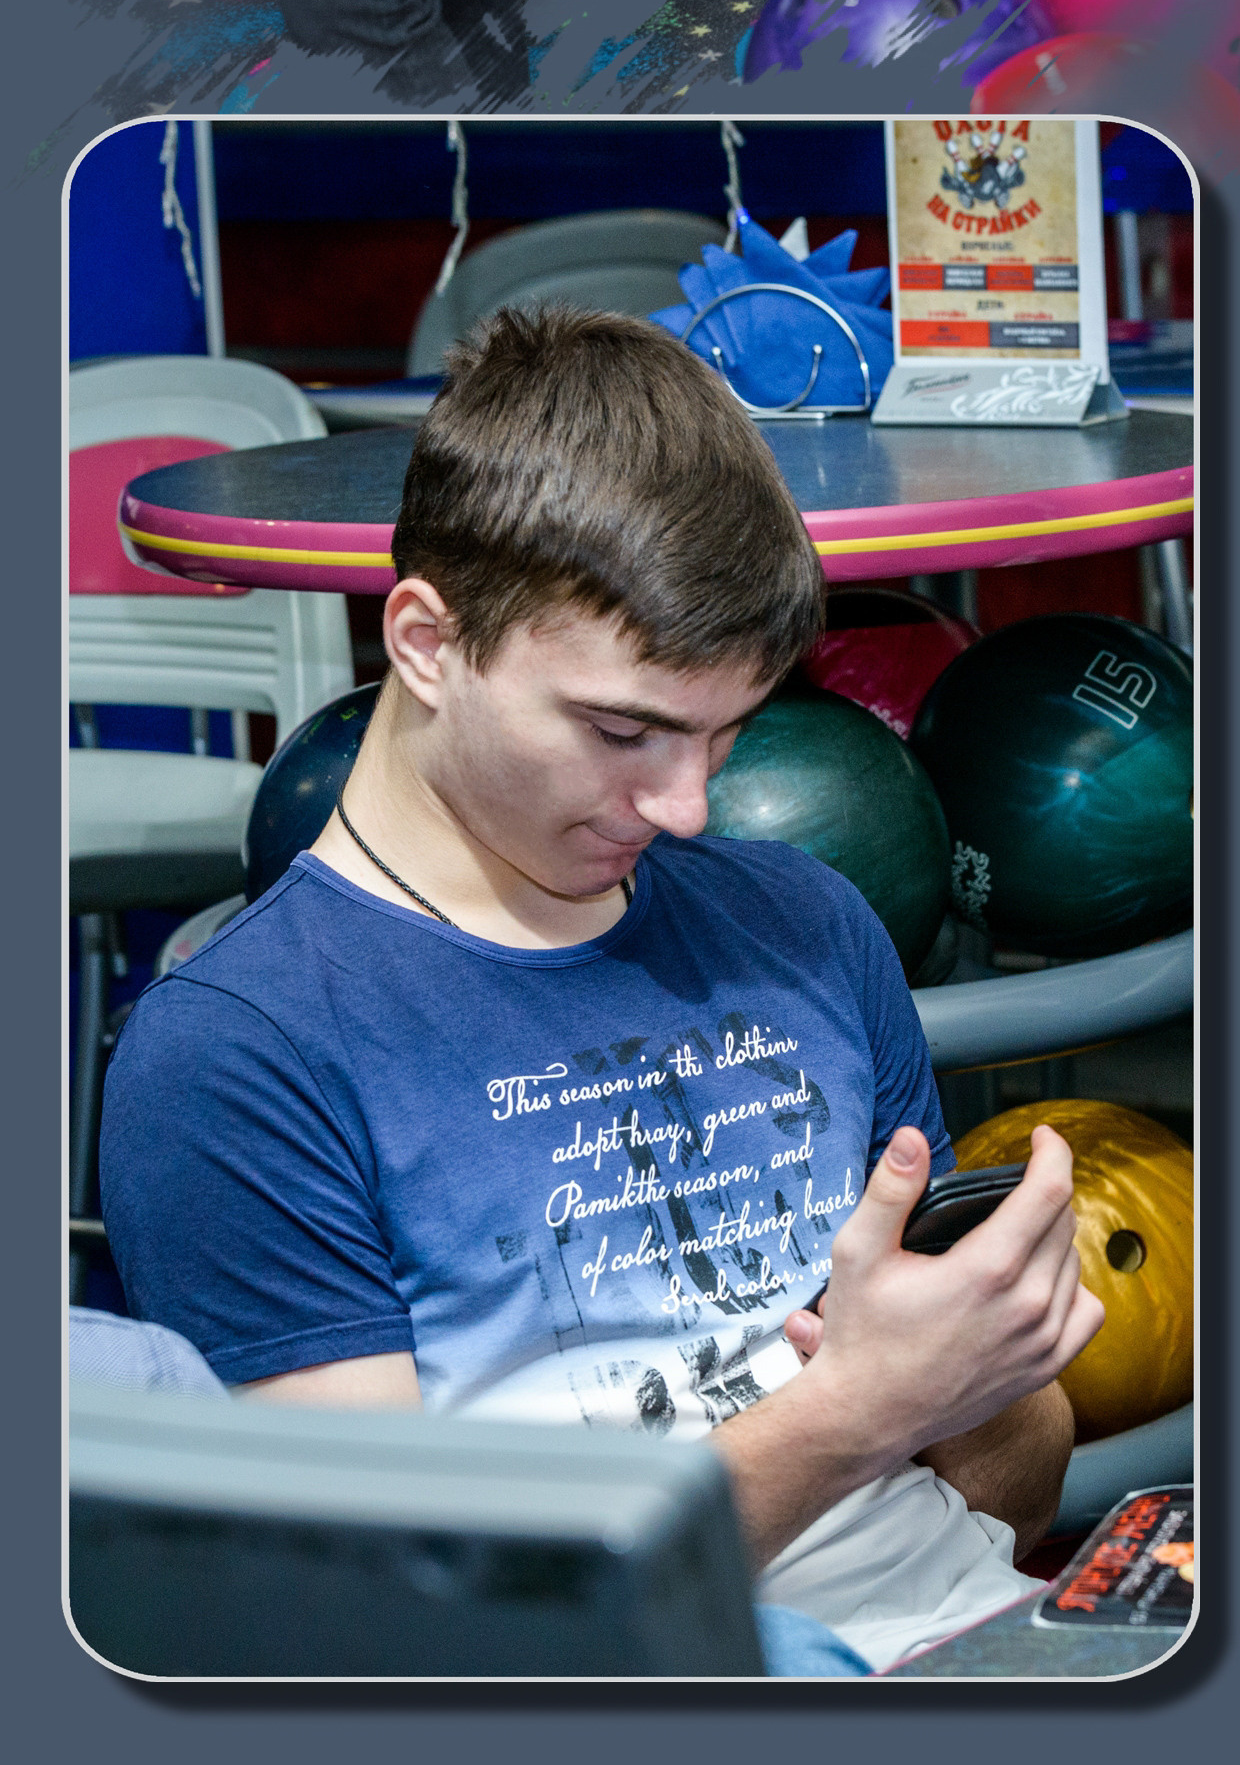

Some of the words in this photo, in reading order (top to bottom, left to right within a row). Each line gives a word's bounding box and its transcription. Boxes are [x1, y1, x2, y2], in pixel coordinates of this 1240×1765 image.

[926, 193, 951, 225] НА
[951, 197, 1042, 236] СТРАЙКИ
[1072, 650, 1157, 730] 15
[487, 1062, 568, 1121] This
[559, 1078, 634, 1105] season
[638, 1055, 667, 1089] in
[703, 1101, 767, 1157] green
[771, 1069, 811, 1110] and
[673, 1165, 760, 1198] season,
[770, 1122, 814, 1170] and
[582, 1235, 607, 1297] of
[611, 1224, 674, 1273] color
[678, 1200, 798, 1253] matching
